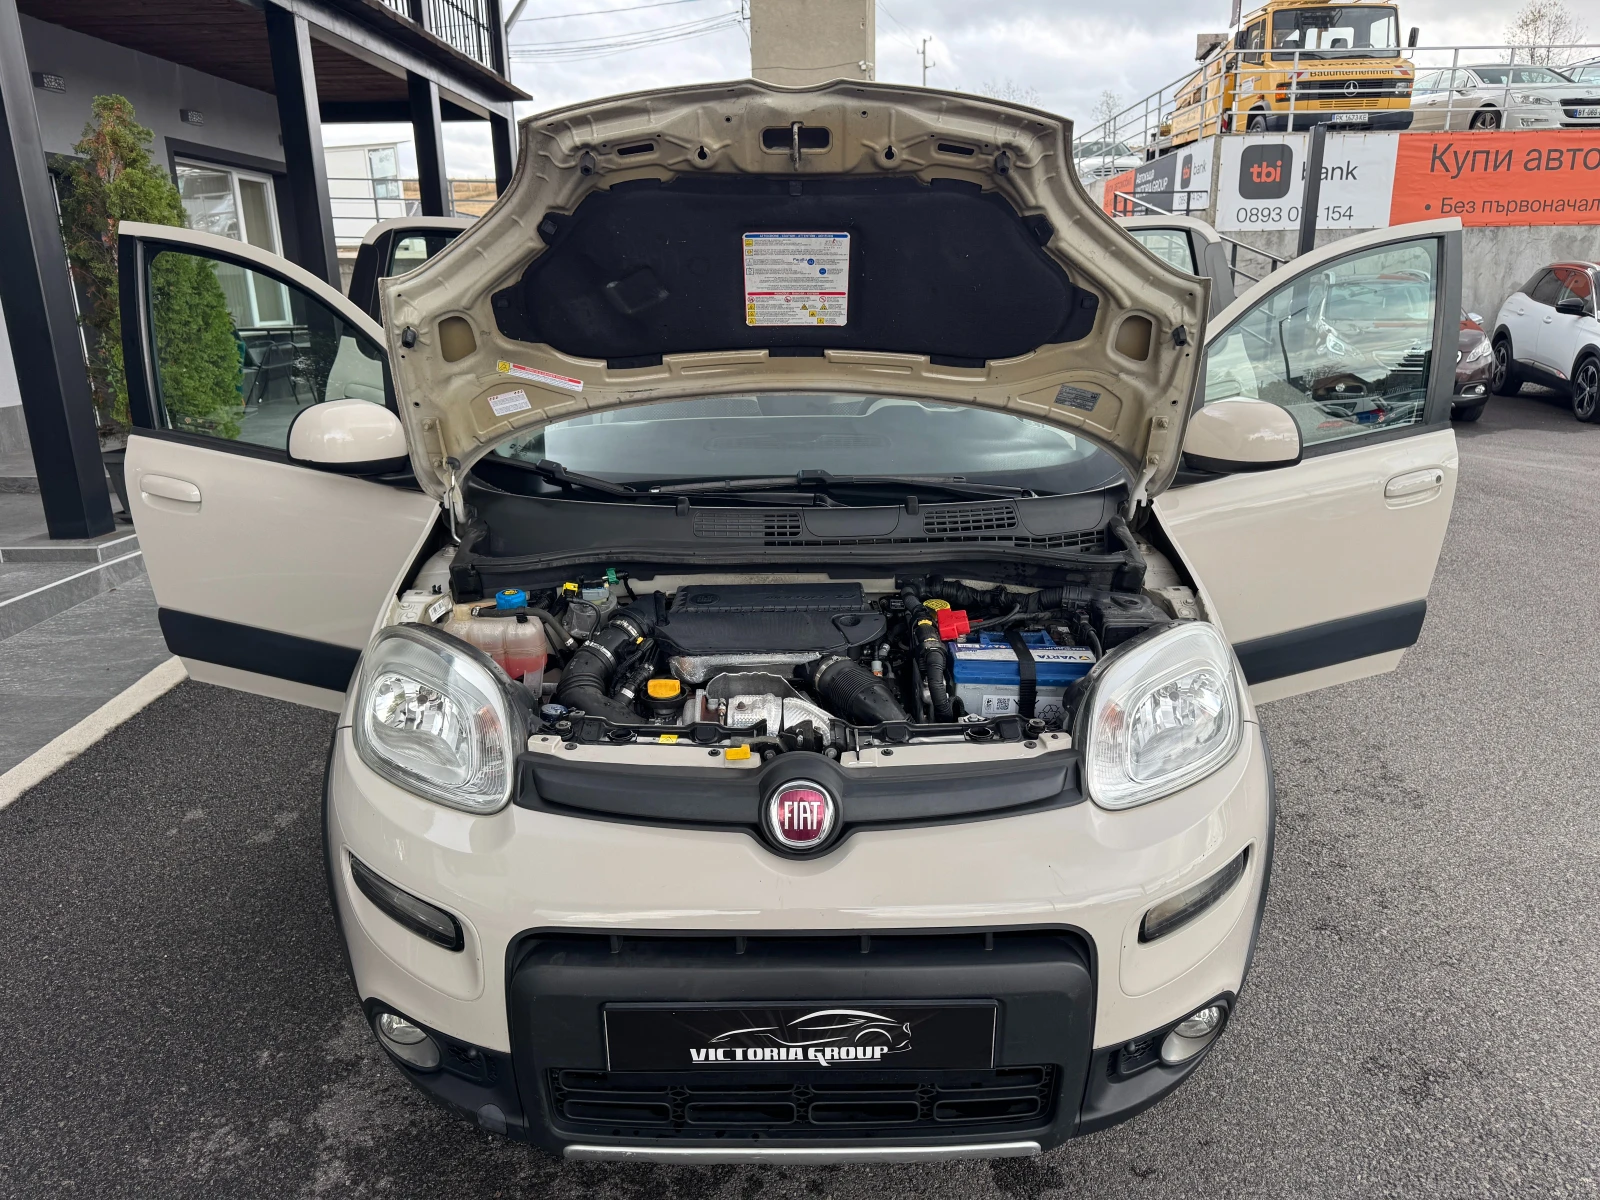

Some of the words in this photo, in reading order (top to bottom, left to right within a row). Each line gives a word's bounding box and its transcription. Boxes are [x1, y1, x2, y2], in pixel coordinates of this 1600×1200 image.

[1193, 160, 1207, 175] bank
[1430, 143, 1514, 179] Купи
[1523, 148, 1600, 171] авто
[1249, 160, 1282, 183] tbi
[1236, 206, 1282, 223] 0893
[1324, 205, 1354, 221] 154
[1441, 197, 1476, 214] Без
[1481, 198, 1600, 216] първоначал
[784, 801, 821, 830] FIAT
[690, 1047, 804, 1062] VICTORIA
[808, 1047, 888, 1066] GROUP
